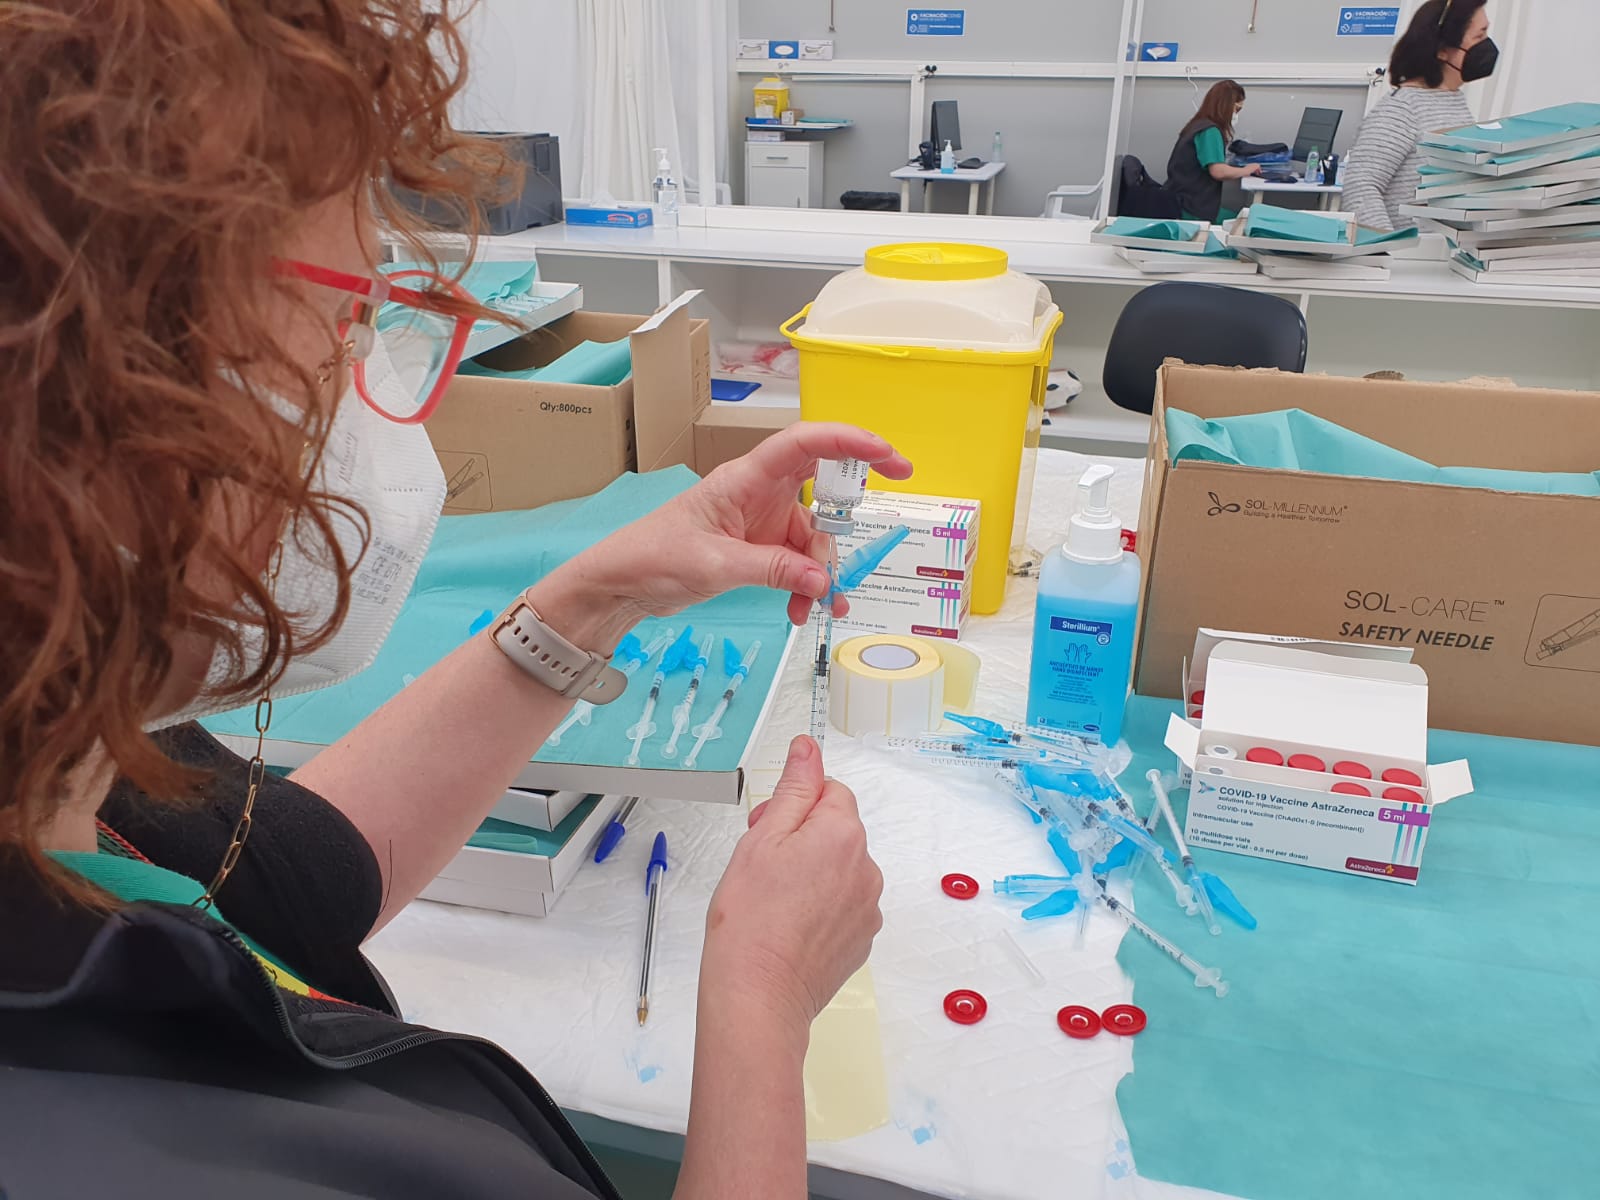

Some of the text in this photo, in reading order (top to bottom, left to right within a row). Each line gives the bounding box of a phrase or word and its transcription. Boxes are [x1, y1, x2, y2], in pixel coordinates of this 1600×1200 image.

[540, 402, 592, 414] Qty:800pcs
[861, 520, 887, 530] Vaccine
[935, 528, 941, 536] 5
[883, 584, 925, 595] AstraZeneca
[930, 588, 936, 596] 5
[1062, 620, 1097, 632] Sterillium
[1339, 621, 1495, 650] SAFETY NEEDLE
[1218, 796, 1244, 804] solution
[1256, 801, 1284, 810] injection
[1219, 786, 1406, 822] COVID-19 Vaccine AstraZeneca 5 ml
[1217, 804, 1247, 814] COVID-19
[1249, 809, 1274, 818] Vaccine
[1200, 829, 1233, 841] multidose
[1235, 836, 1251, 844] vials
[1201, 836, 1222, 845] doses
[1236, 841, 1248, 850] vial
[1266, 847, 1275, 855] ml
[1289, 852, 1309, 861] dose)
[1349, 862, 1386, 874] AstraZeneca
